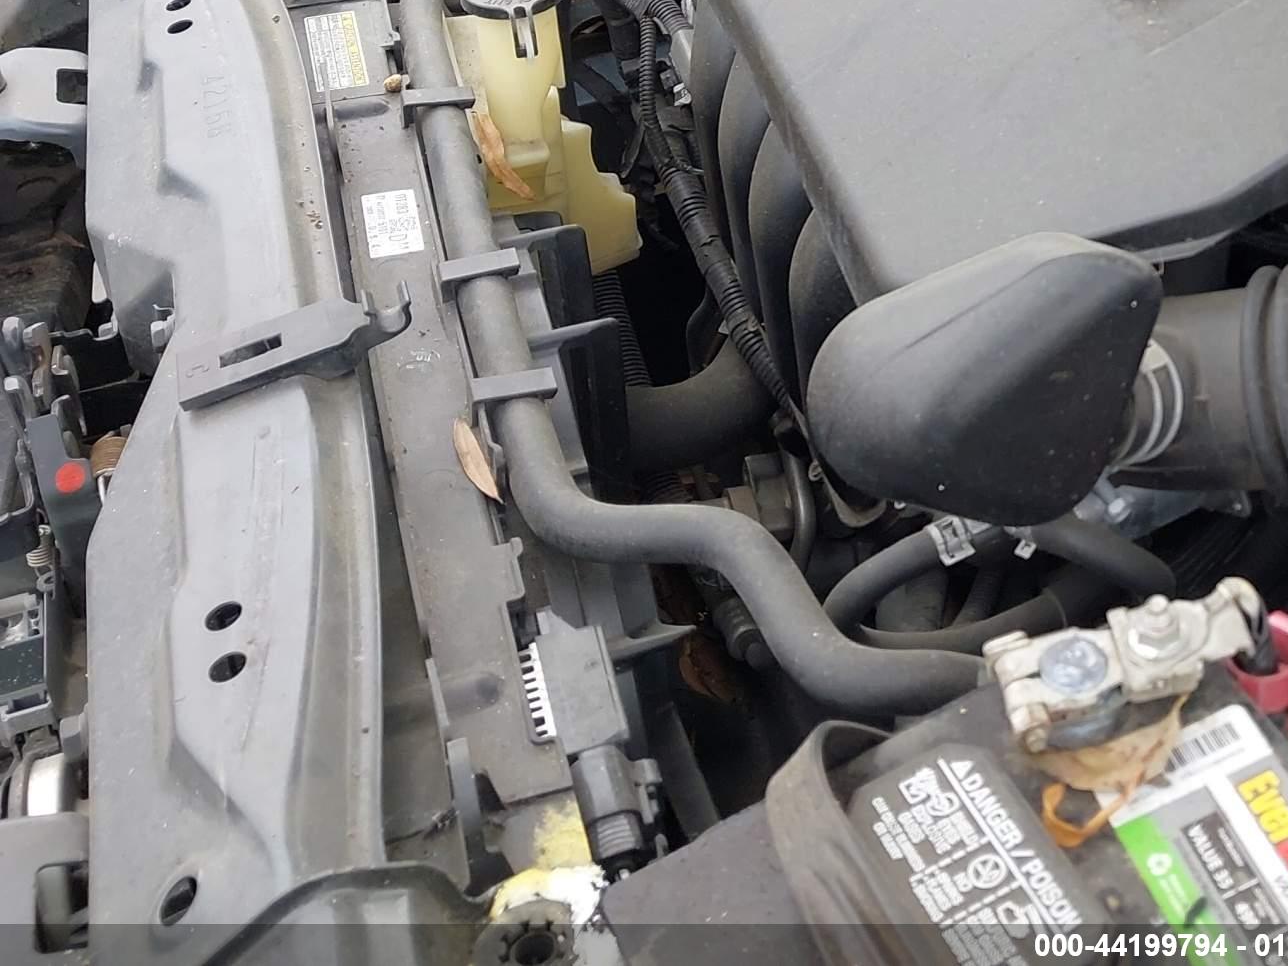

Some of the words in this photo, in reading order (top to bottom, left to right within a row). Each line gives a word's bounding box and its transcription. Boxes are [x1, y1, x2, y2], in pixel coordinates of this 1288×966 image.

[960, 773, 1024, 851] DANGER
[1021, 859, 1083, 934] POISON
[1187, 822, 1225, 876] VALUE
